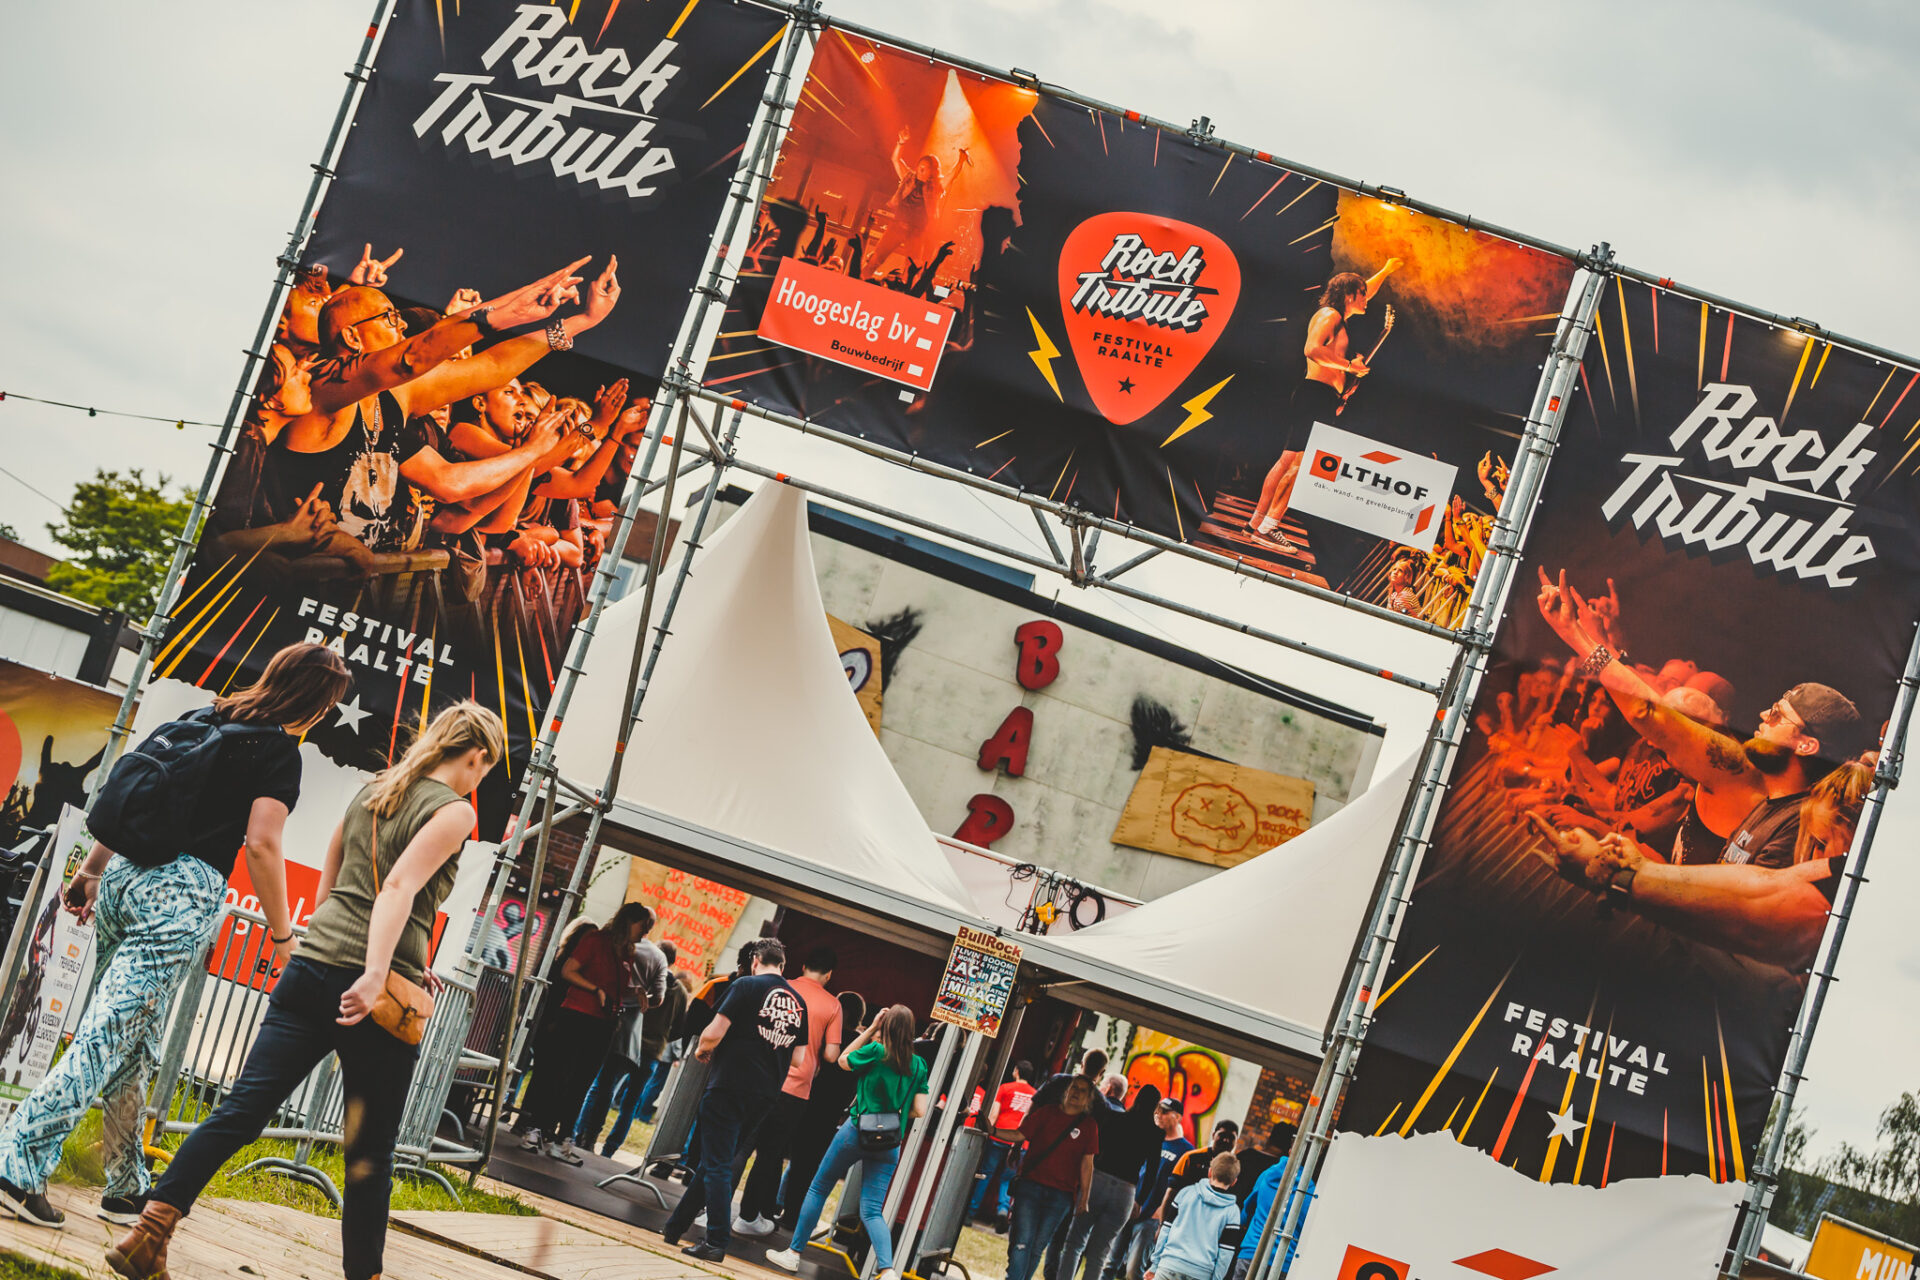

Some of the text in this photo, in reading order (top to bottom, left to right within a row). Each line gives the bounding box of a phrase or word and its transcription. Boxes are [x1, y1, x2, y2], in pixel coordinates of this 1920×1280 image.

[481, 3, 681, 114] Rock
[412, 72, 676, 198] Tribute
[1100, 233, 1204, 285] Rock
[776, 277, 917, 344] Hoogeslag bv
[1070, 272, 1208, 329] Tribute
[830, 339, 905, 372] Bouwbedrijf
[1093, 331, 1173, 357] FESTIVAL
[1098, 346, 1164, 368] RAALTE
[1669, 382, 1877, 501] Rock
[1320, 455, 1429, 501] OLTHOF
[1333, 488, 1354, 499] wand-
[1355, 495, 1365, 503] en
[1365, 497, 1415, 520] gevelbeplating
[1601, 453, 1876, 588] Tribute
[298, 596, 455, 666] FESTIVAL
[304, 626, 434, 686] RAALTE
[1267, 802, 1304, 826] ROCK
[641, 881, 691, 909] WOULD
[957, 926, 1022, 957] BullRock
[966, 942, 995, 954] november
[999, 967, 1013, 976] MAN
[947, 980, 1005, 1007] MIRAGE
[758, 1005, 801, 1029] speed
[774, 1019, 789, 1035] or
[932, 1011, 960, 1024] BullRock
[1503, 1001, 1669, 1075] FESTIVAL
[1511, 1032, 1649, 1095] RAALTE
